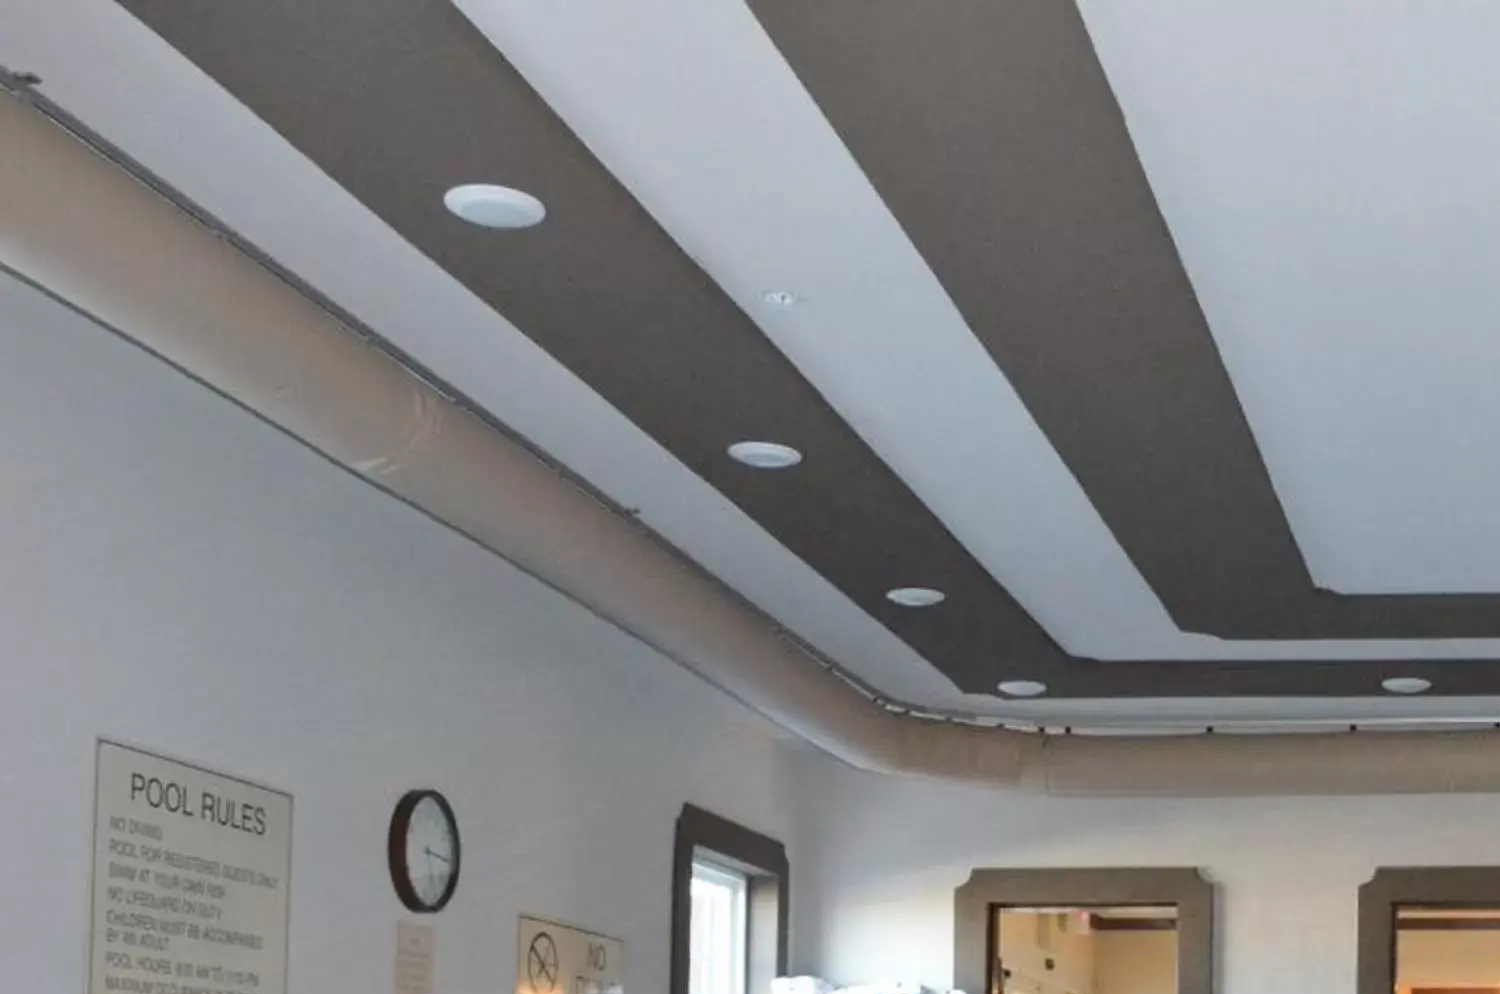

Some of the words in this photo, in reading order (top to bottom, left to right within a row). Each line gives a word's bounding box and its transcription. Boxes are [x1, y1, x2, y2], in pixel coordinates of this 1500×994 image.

[130, 772, 194, 817] POOL
[201, 792, 267, 836] RULES
[587, 942, 605, 970] NO
